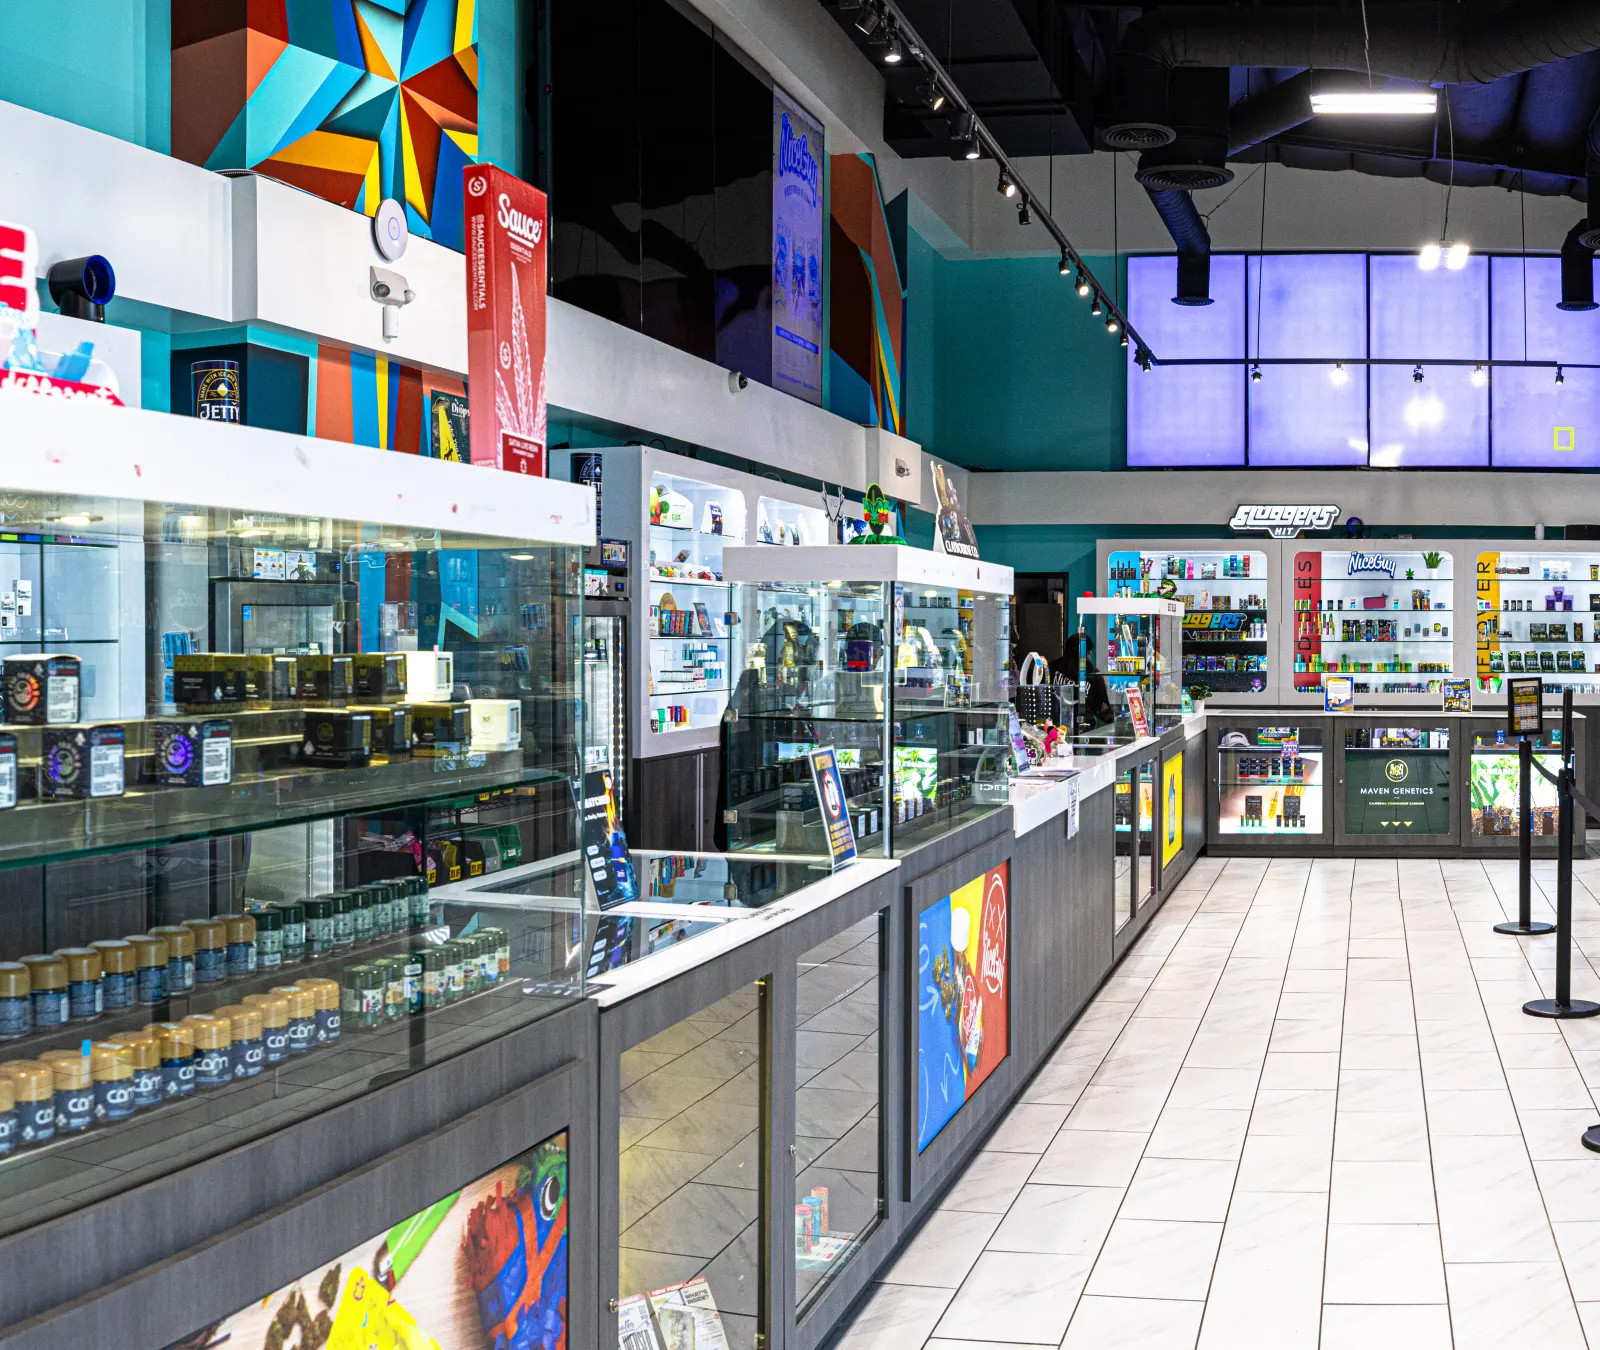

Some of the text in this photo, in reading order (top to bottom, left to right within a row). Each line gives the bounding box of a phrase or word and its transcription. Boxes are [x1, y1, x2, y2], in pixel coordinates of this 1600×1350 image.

[498, 193, 542, 243] Sauce
[206, 373, 217, 383] WITH
[1348, 551, 1396, 579] NiceGuy
[685, 1289, 708, 1299] WHAT'S
[688, 1295, 709, 1304] INSIDE?
